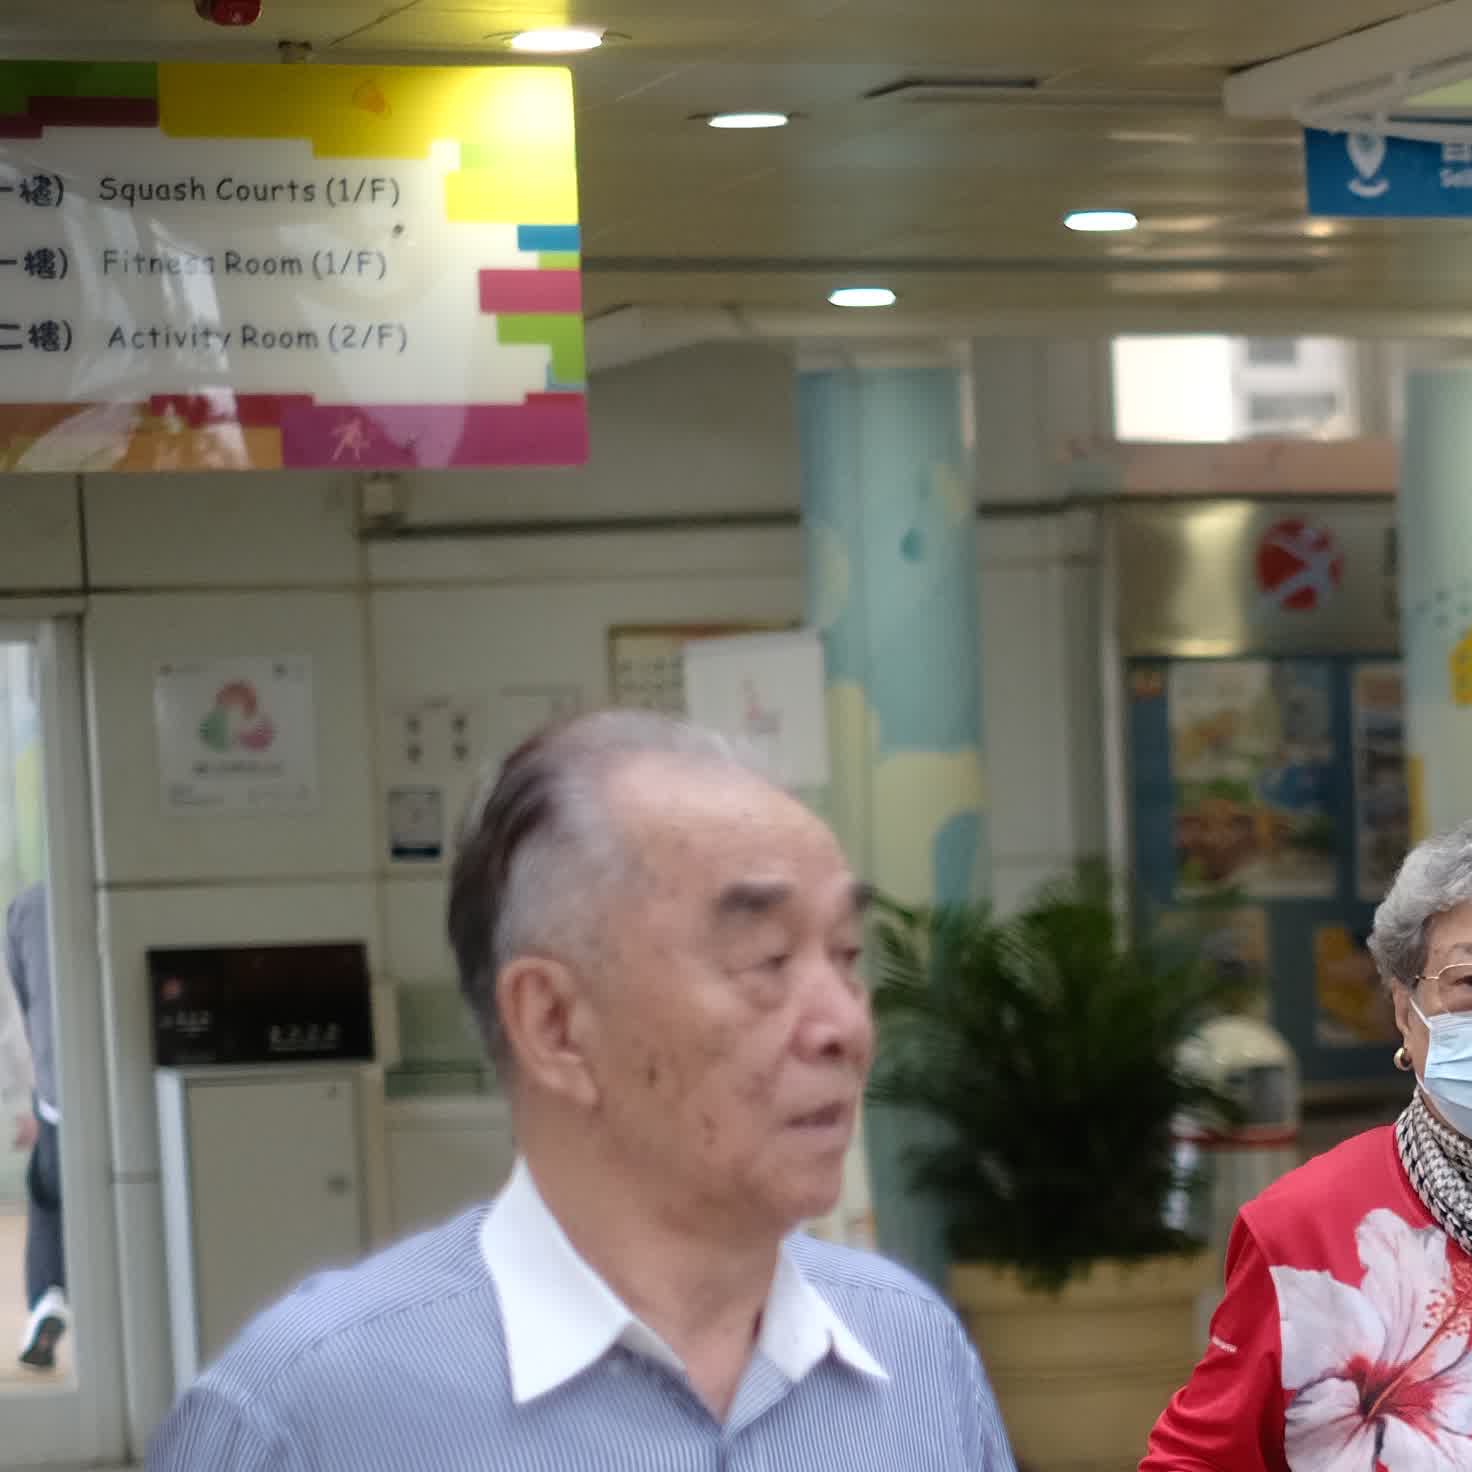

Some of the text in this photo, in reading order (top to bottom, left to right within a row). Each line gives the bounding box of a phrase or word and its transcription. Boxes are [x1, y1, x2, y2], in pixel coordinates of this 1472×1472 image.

[98, 177, 206, 209] Squash
[215, 177, 316, 203] Courts
[325, 176, 400, 208] (1/F)
[225, 250, 303, 276] Room
[312, 249, 388, 281] (1/F)
[108, 325, 232, 352] Activity
[242, 324, 318, 350] Room
[328, 323, 408, 353] (2/F)
